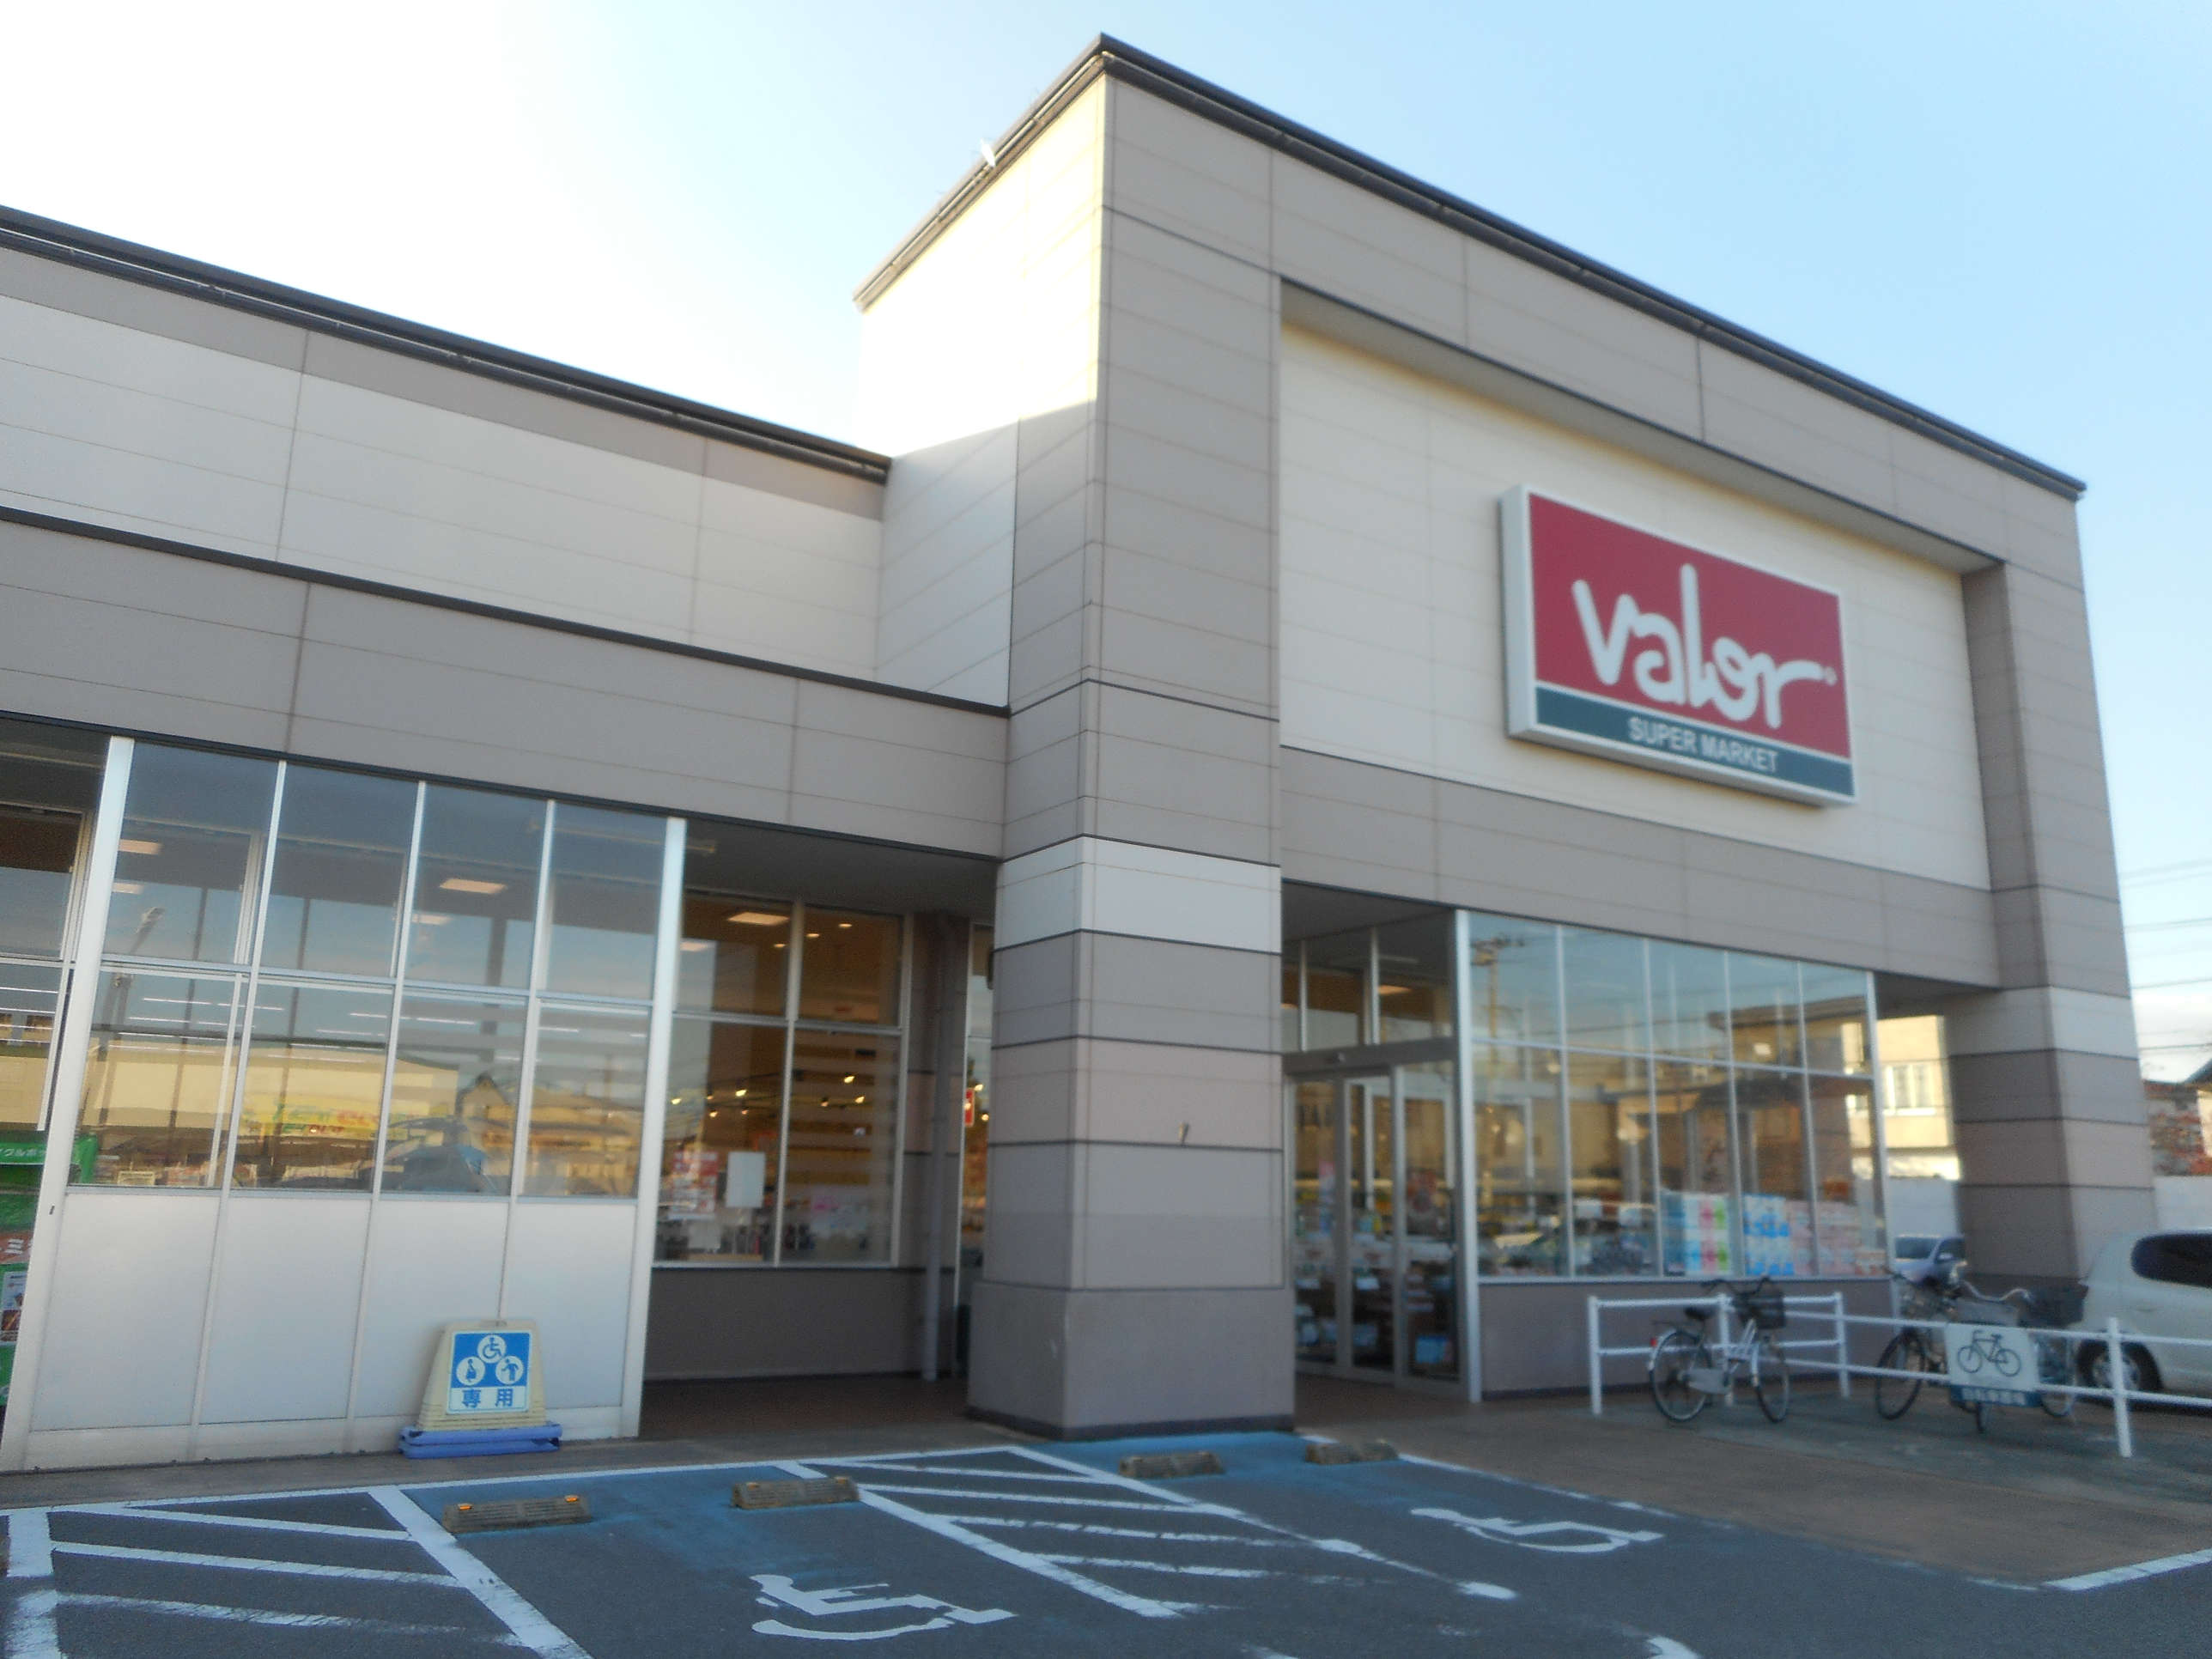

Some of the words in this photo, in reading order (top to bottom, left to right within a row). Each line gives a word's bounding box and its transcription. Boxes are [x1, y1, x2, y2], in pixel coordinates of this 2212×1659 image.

[1628, 716, 1698, 754] SUPER
[1700, 734, 1779, 773] MARKET
[461, 1389, 514, 1408] 専用
